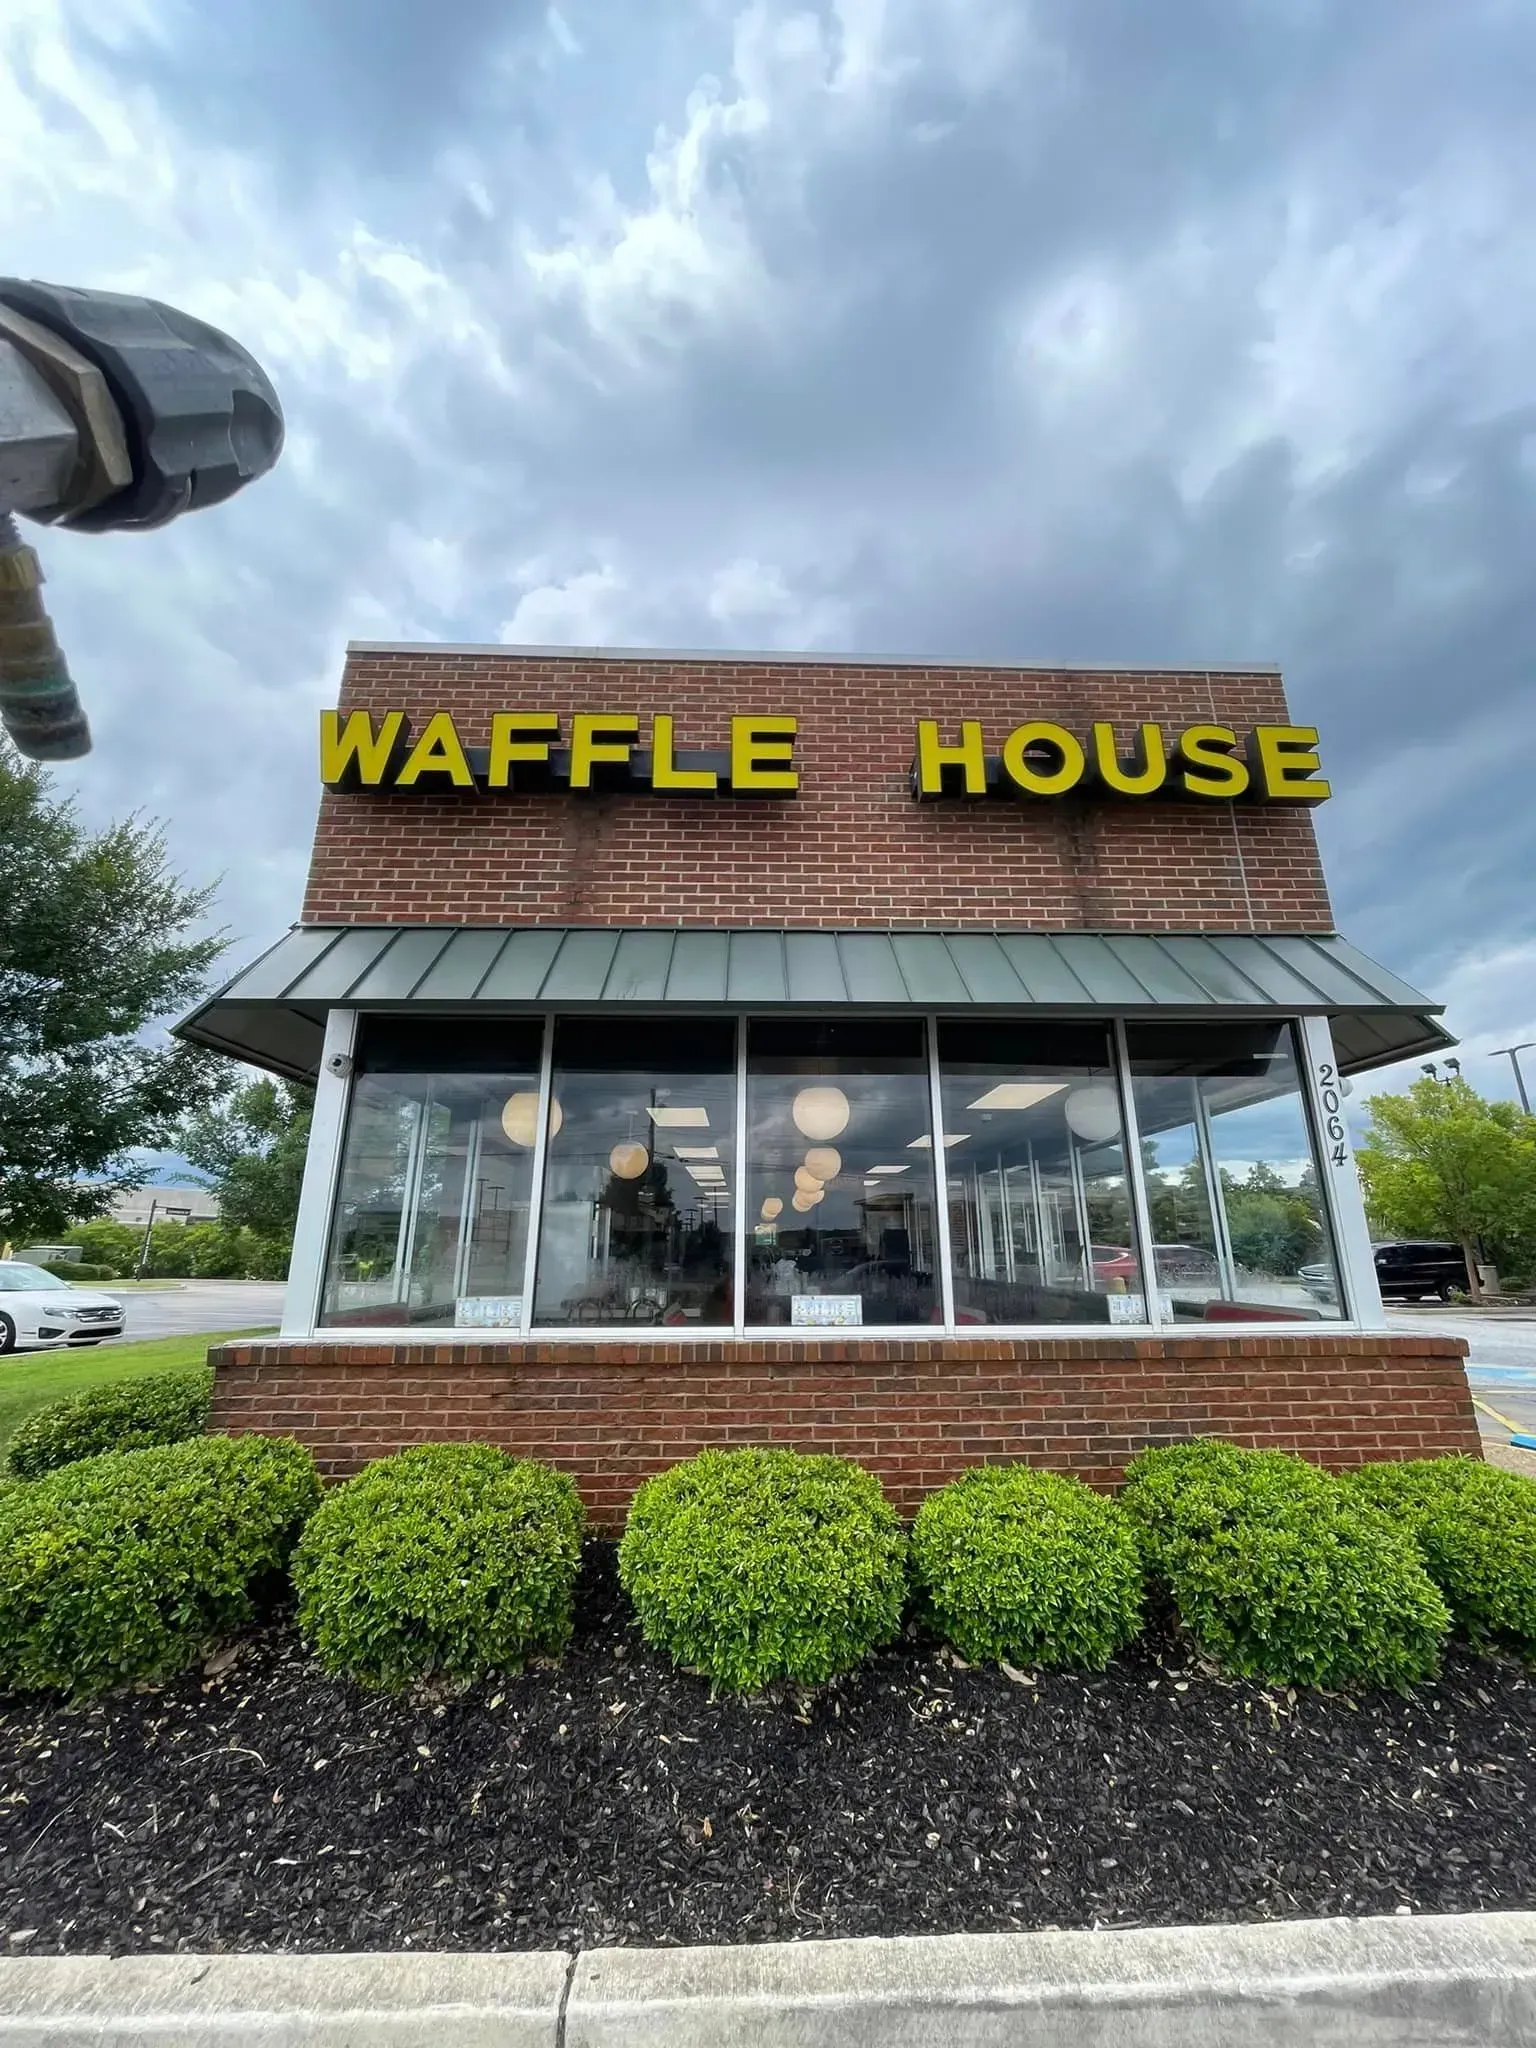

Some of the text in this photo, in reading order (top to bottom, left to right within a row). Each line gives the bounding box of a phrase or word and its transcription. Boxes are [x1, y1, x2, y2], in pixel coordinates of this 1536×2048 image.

[320, 709, 1331, 800] WAFFLE HOUSE
[1319, 1064, 1348, 1167] 2064
